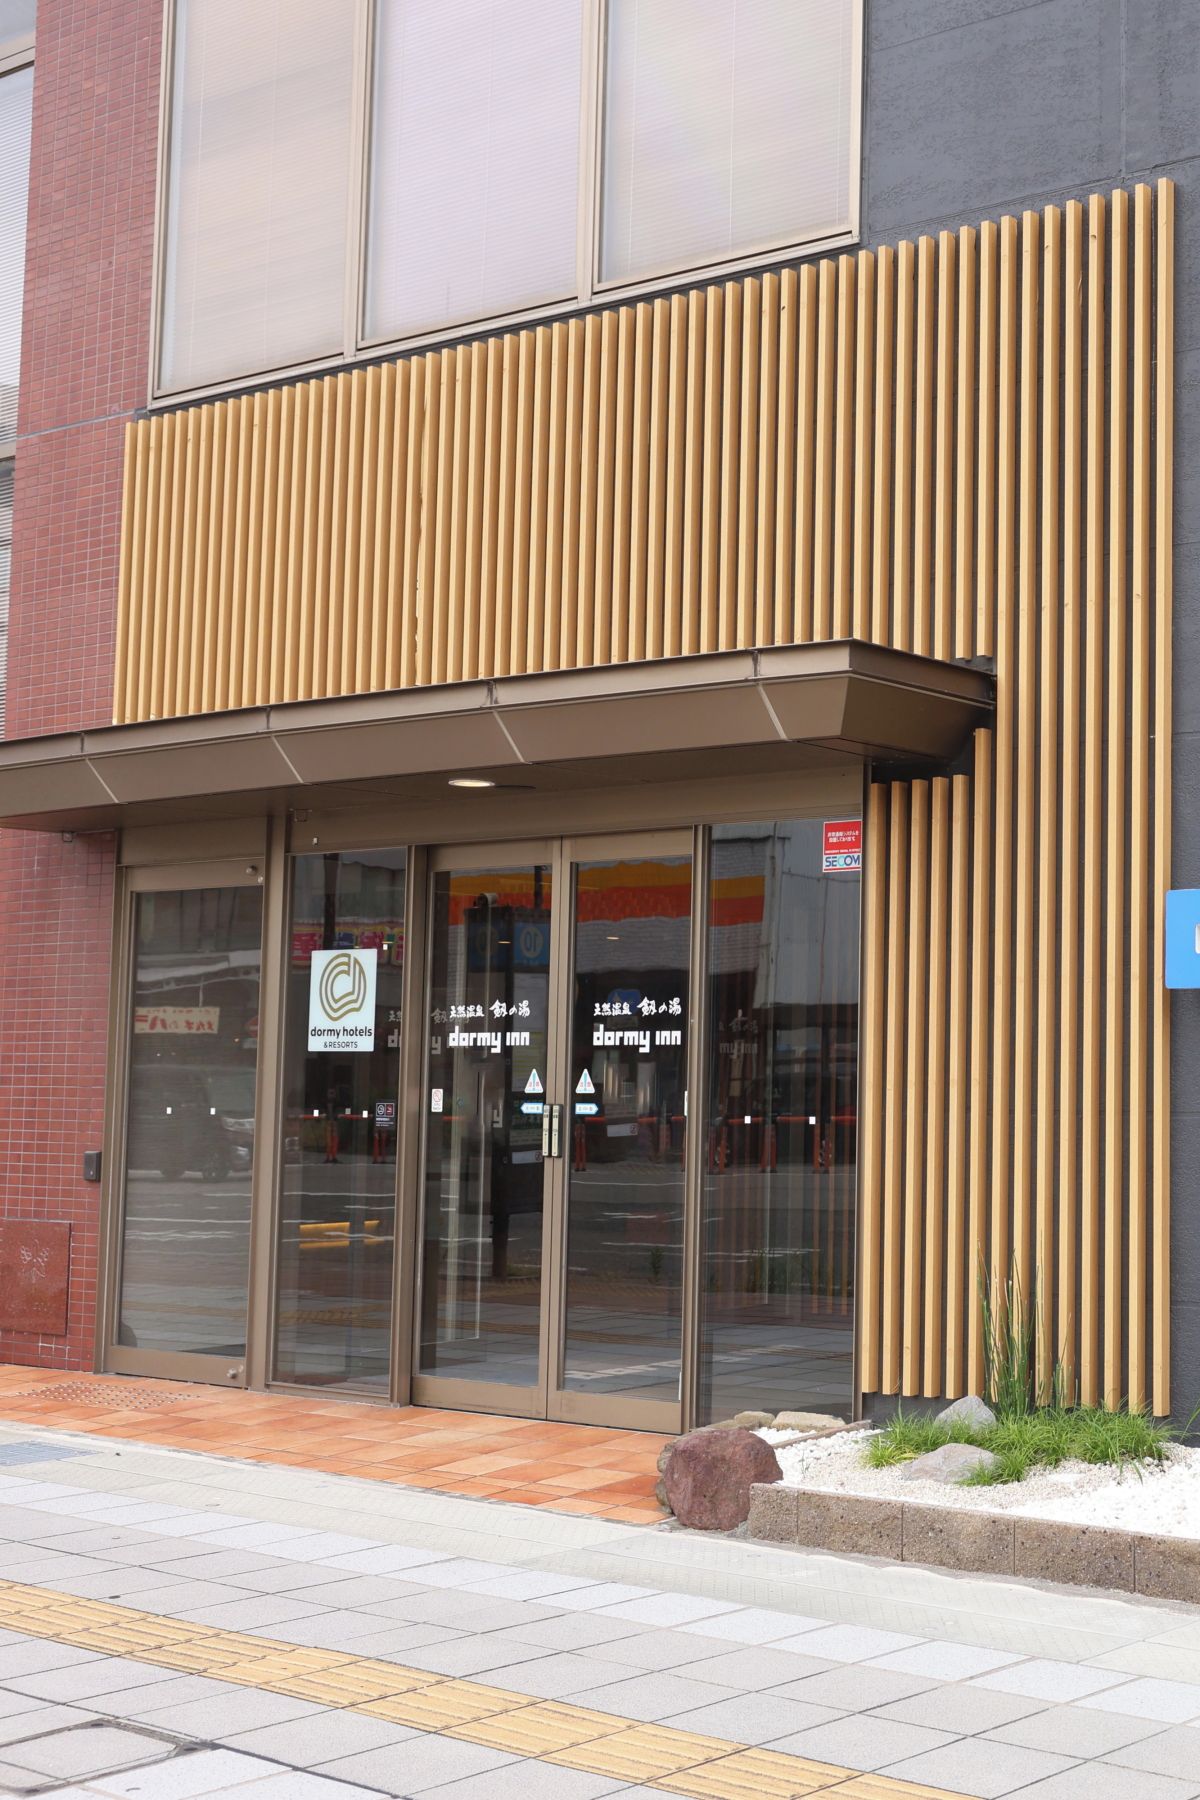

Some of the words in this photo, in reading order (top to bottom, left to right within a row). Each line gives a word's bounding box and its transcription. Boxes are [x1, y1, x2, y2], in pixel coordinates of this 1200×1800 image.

[825, 854, 860, 867] SECOM
[450, 1005, 485, 1019] 天然温泉
[593, 1002, 632, 1017] 天然温泉
[310, 1025, 342, 1039] dormy
[342, 1025, 373, 1037] hotels
[449, 1025, 502, 1053] dormy
[506, 1031, 530, 1046] inn
[593, 1023, 650, 1053] dormy
[655, 1030, 682, 1046] inn
